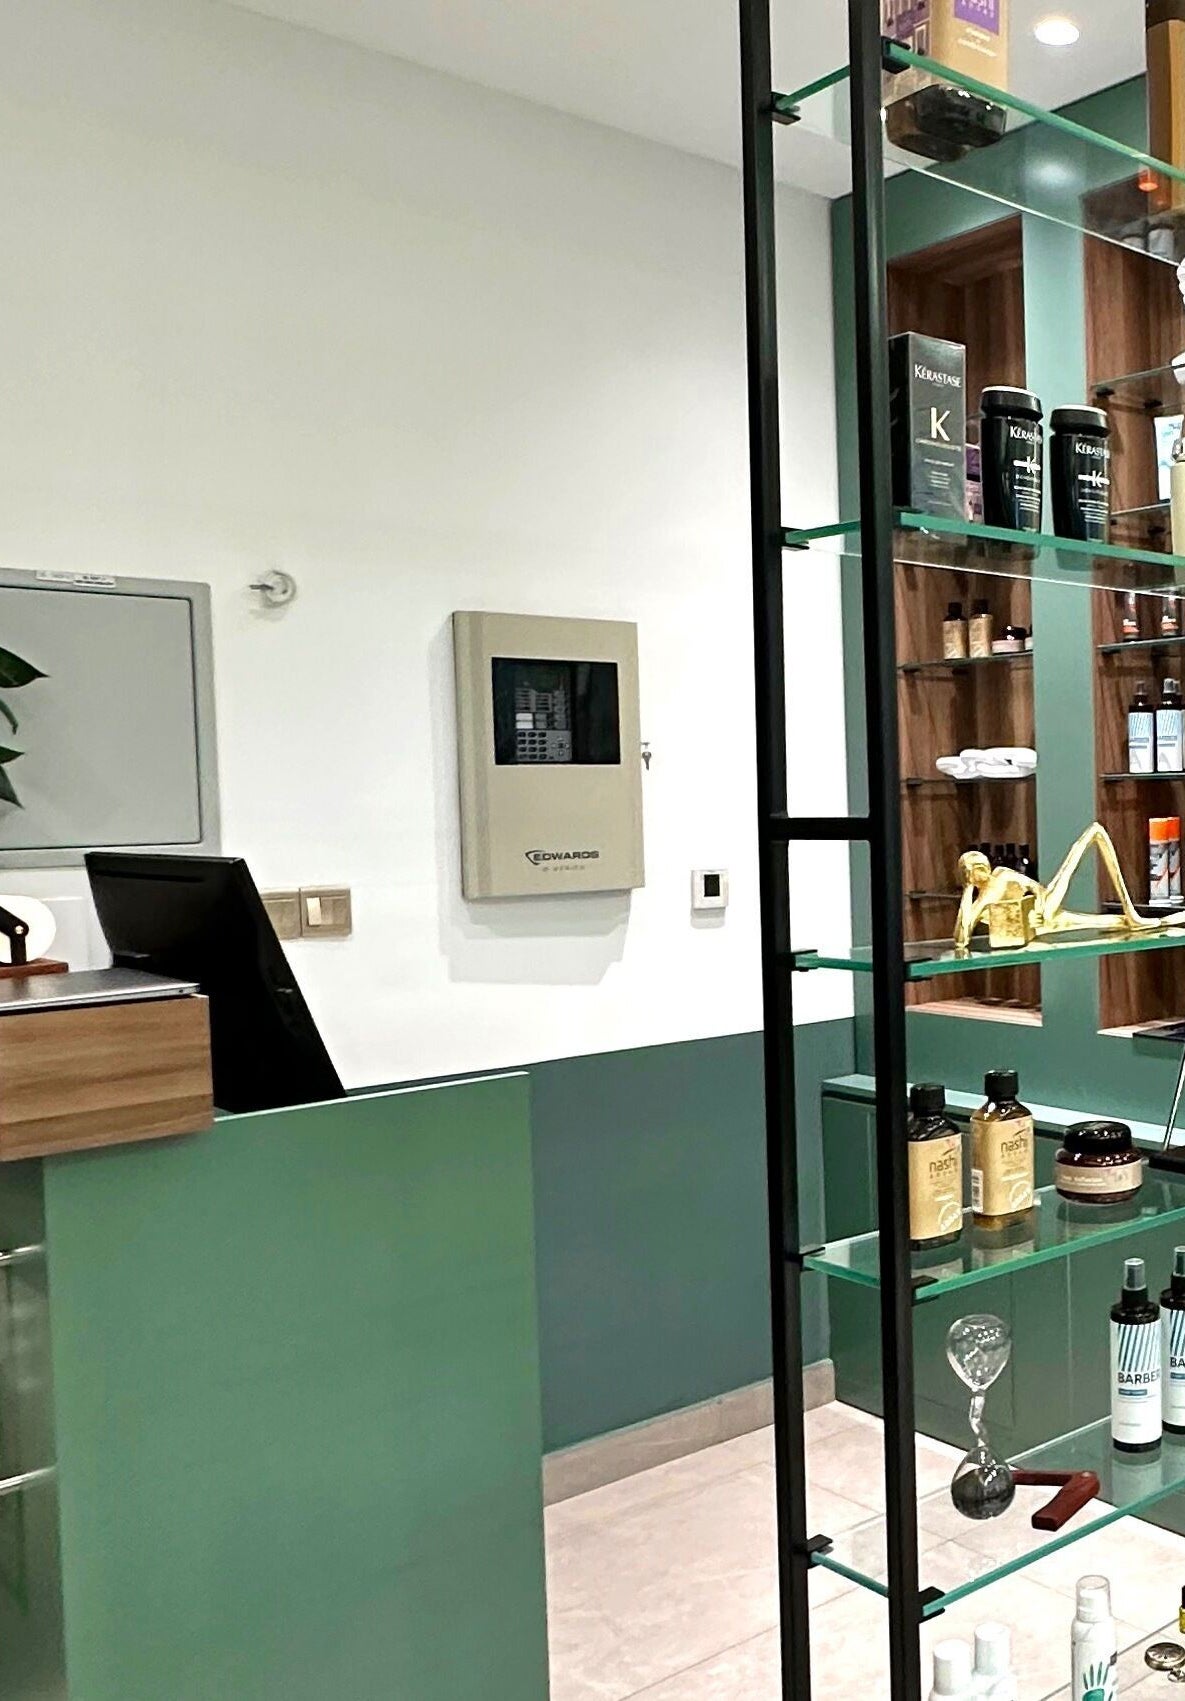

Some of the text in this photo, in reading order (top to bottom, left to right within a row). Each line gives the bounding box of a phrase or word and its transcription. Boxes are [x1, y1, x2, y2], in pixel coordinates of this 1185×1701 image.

[914, 363, 962, 388] KÉRASTASE
[930, 406, 950, 441] K
[529, 850, 600, 862] EDWARDS
